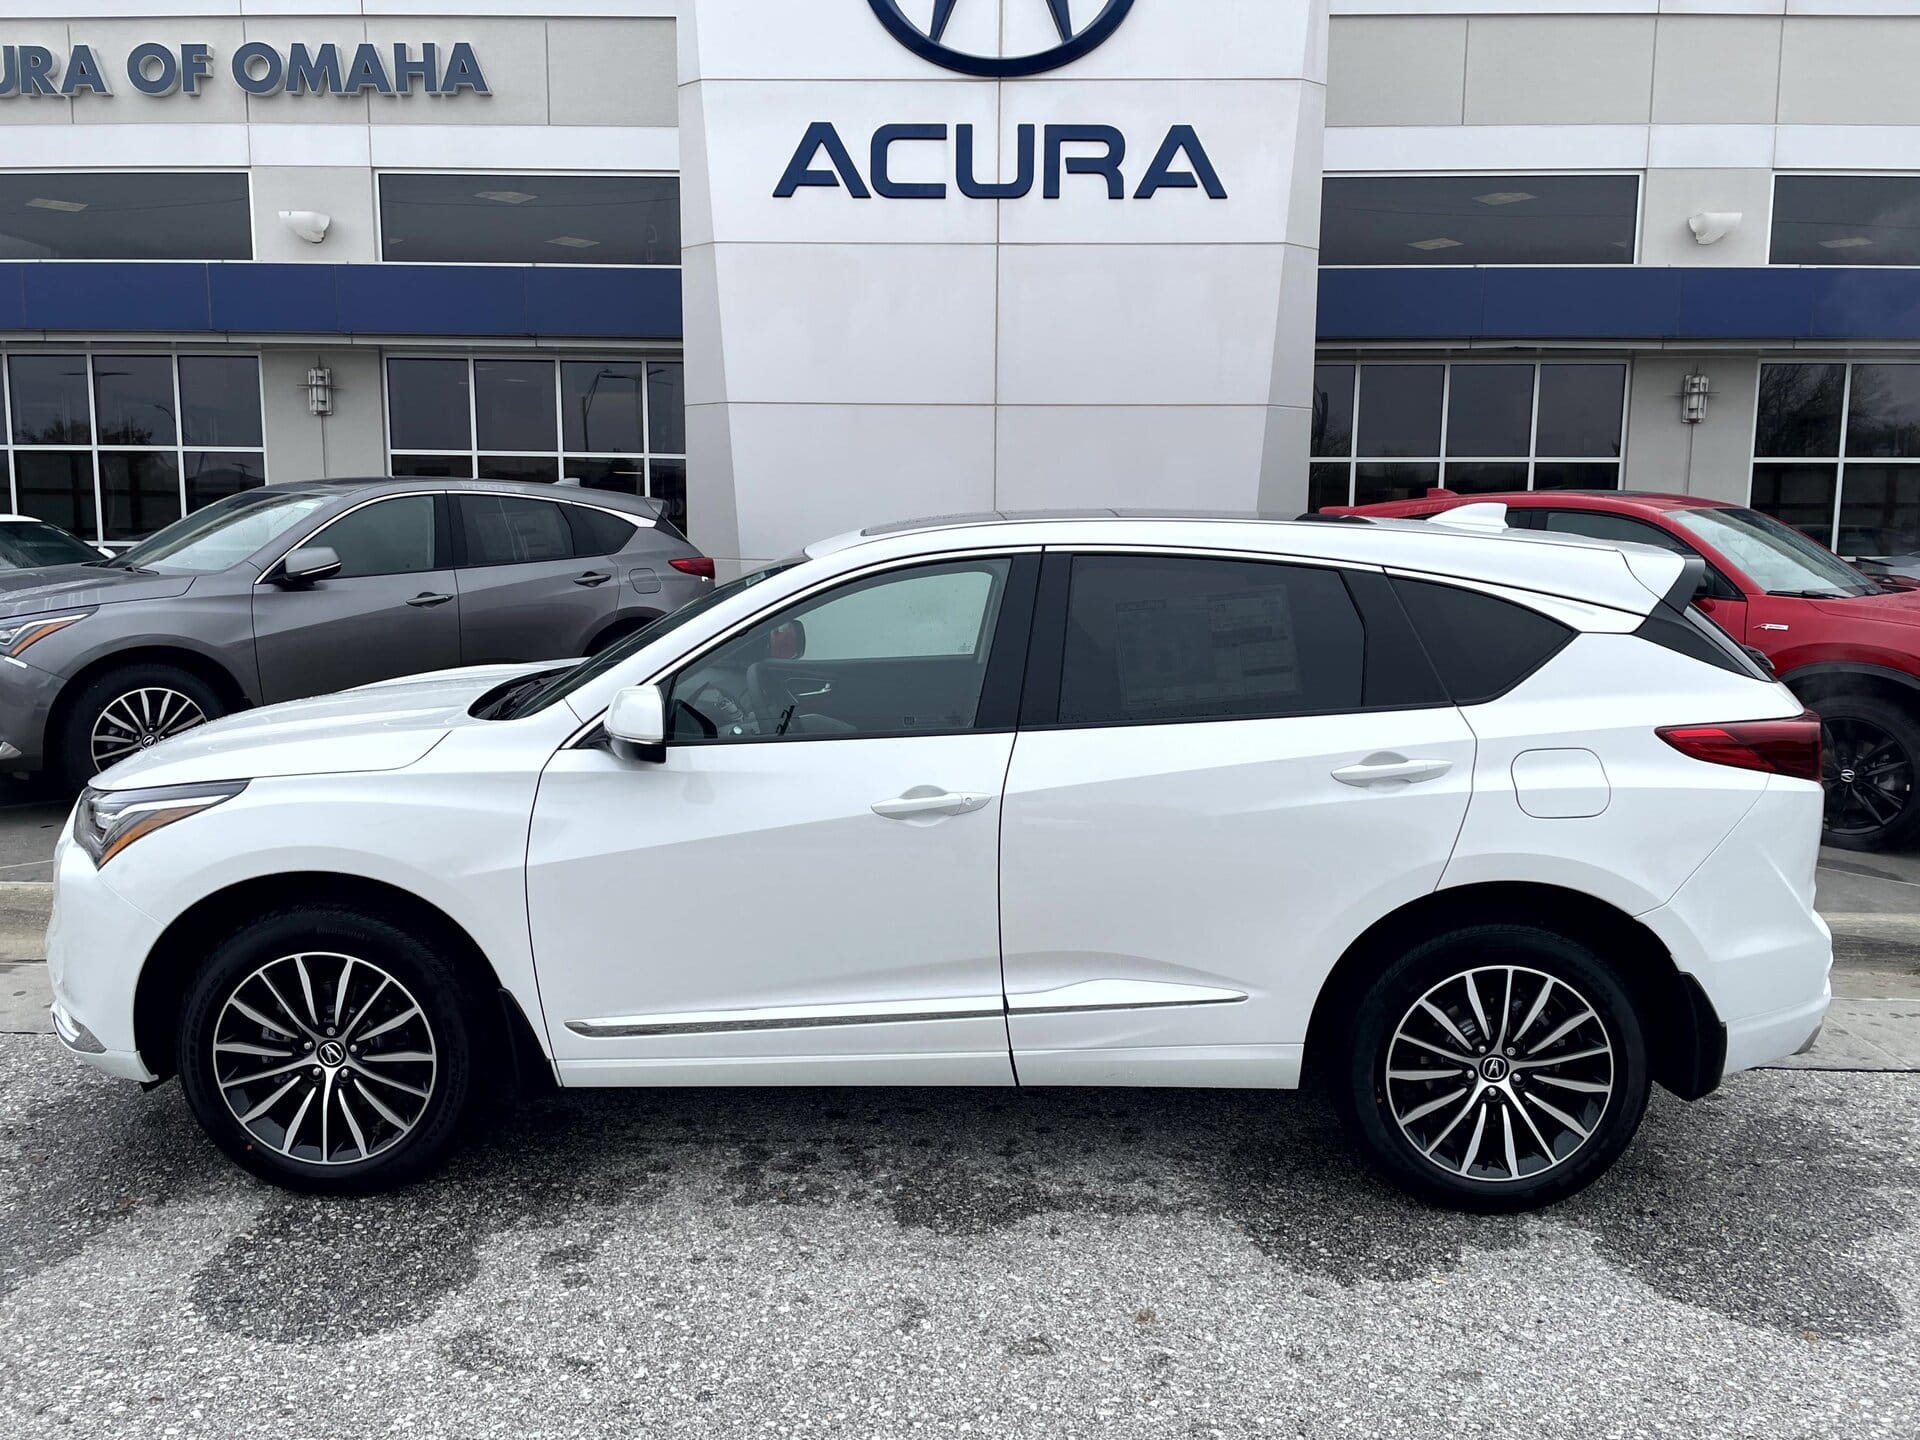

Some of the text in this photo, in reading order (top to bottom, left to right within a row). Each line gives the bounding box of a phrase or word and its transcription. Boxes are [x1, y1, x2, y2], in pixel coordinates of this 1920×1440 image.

[127, 42, 212, 96] OF
[231, 41, 491, 96] OMAHA
[772, 121, 1228, 200] ACURA
